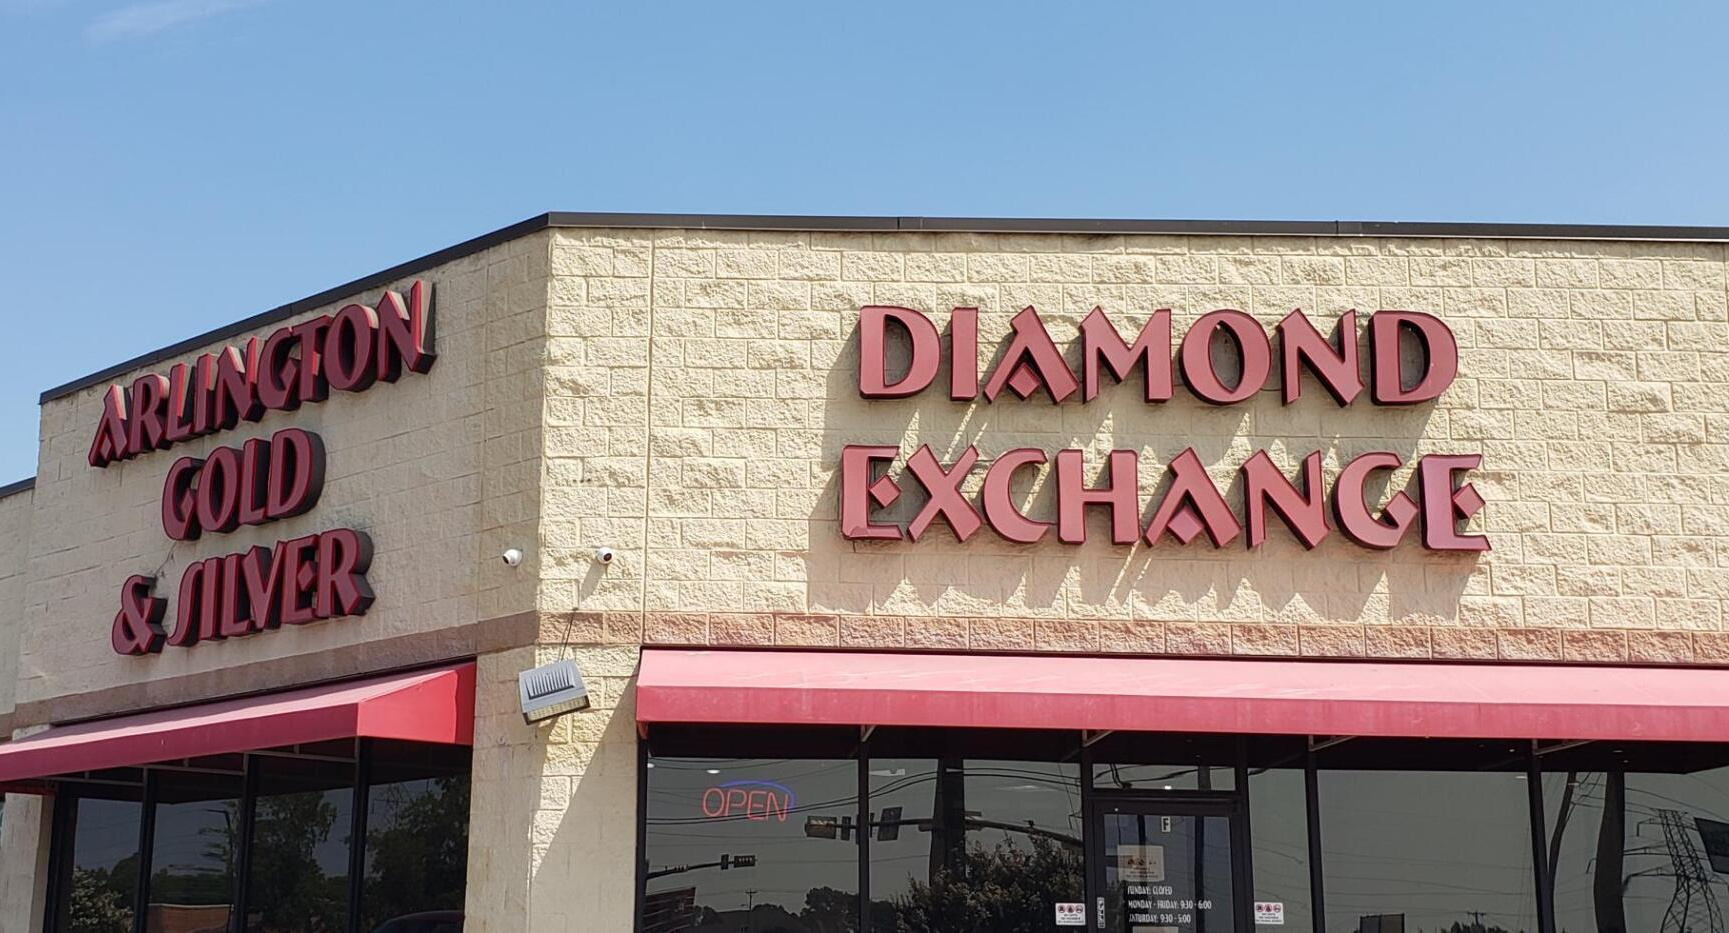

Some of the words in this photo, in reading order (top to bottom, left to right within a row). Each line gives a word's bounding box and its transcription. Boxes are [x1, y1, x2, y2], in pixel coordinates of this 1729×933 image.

[88, 279, 437, 468] ARLINGTON
[857, 304, 1460, 406] DIAMOND
[161, 427, 326, 541] GOLD
[840, 443, 1492, 551] EXCHANGE
[112, 574, 168, 656] &
[167, 527, 375, 648] SILVER
[702, 787, 789, 823] OPEN
[1163, 817, 1169, 831] F
